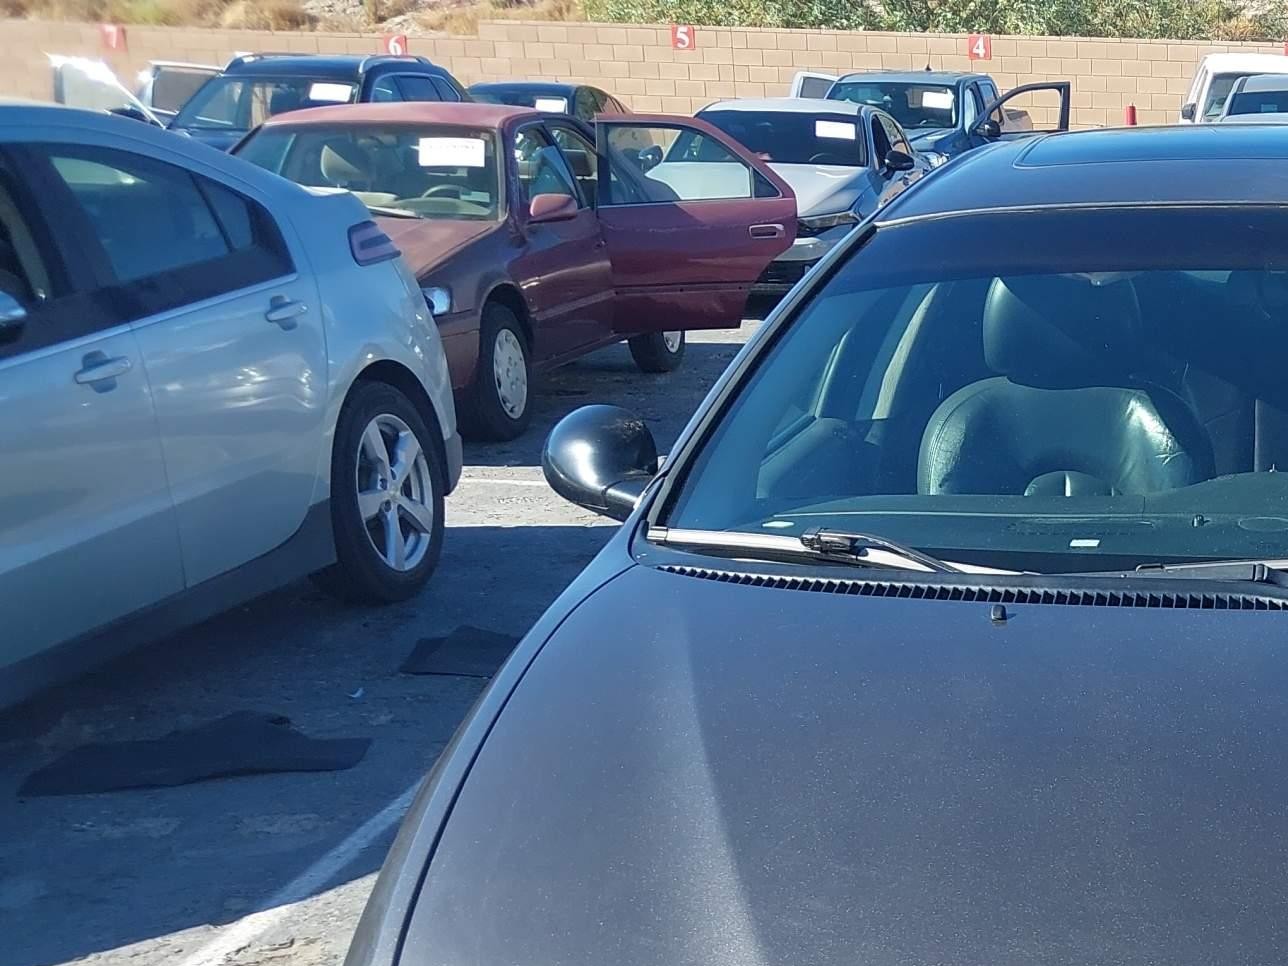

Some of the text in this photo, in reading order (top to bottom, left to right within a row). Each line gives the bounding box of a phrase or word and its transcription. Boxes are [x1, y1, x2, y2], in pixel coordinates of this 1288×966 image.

[388, 35, 403, 55] 6
[675, 25, 692, 49] 5
[971, 36, 986, 58] 4
